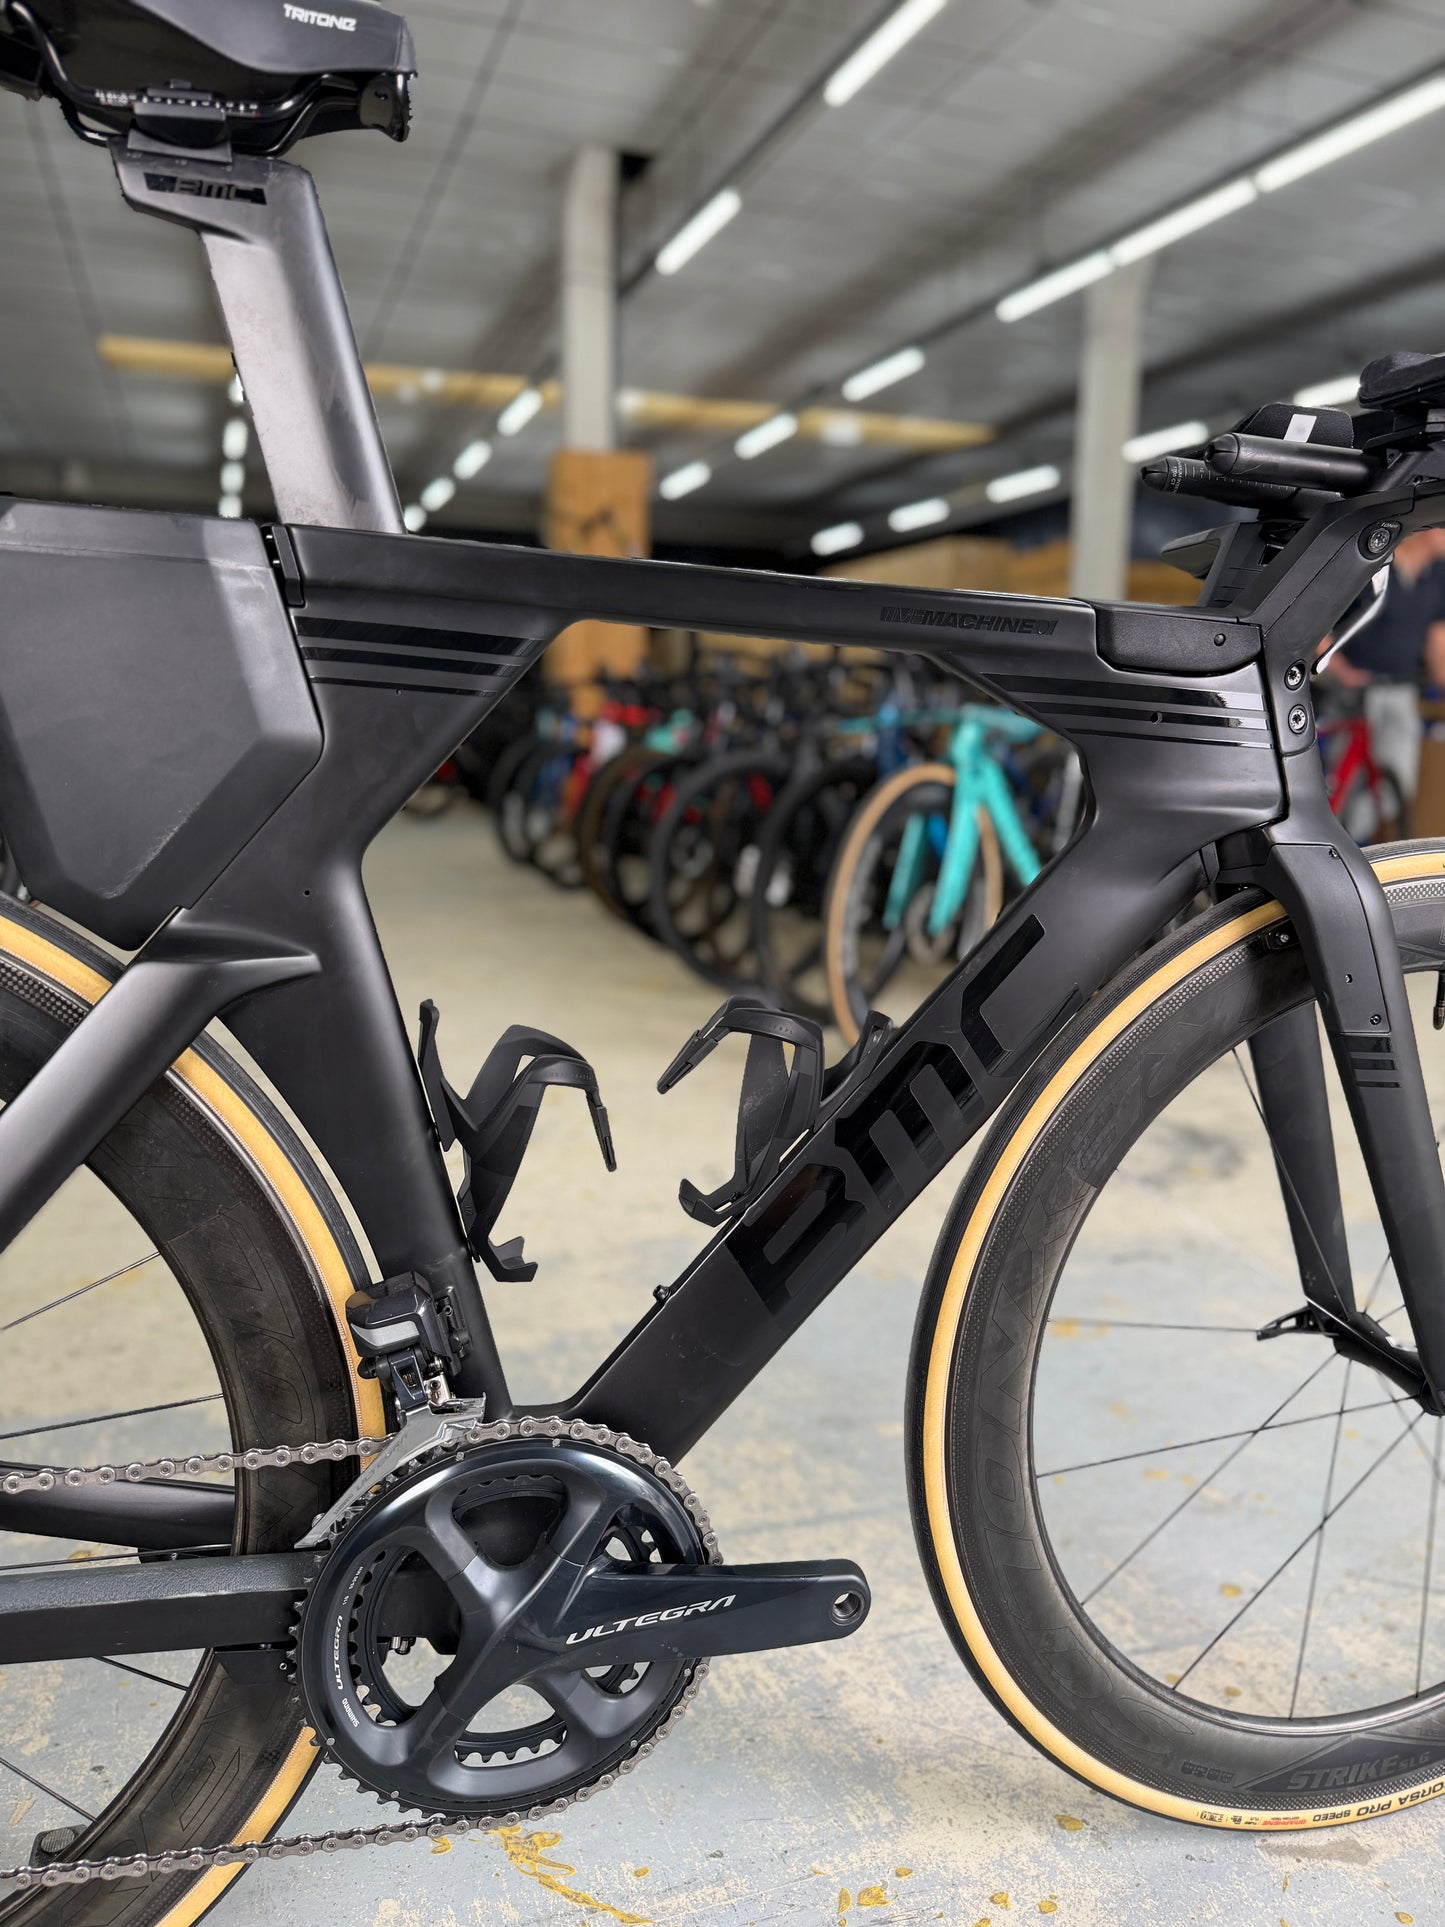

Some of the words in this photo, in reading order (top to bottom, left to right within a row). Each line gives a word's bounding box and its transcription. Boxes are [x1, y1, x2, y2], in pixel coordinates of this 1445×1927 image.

[283, 3, 357, 32] TRITONE
[172, 176, 257, 204] BMC
[724, 912, 1086, 1330] BMC
[565, 1594, 737, 1645] ULTEGRA
[333, 1615, 344, 1690] ULTEGRA
[341, 1697, 360, 1728] SHIMANO
[1286, 1754, 1400, 1790] STRIKE
[1356, 1799, 1393, 1817] PRO
[1398, 1780, 1445, 1806] ORSA
[1312, 1809, 1352, 1822] SPEED
